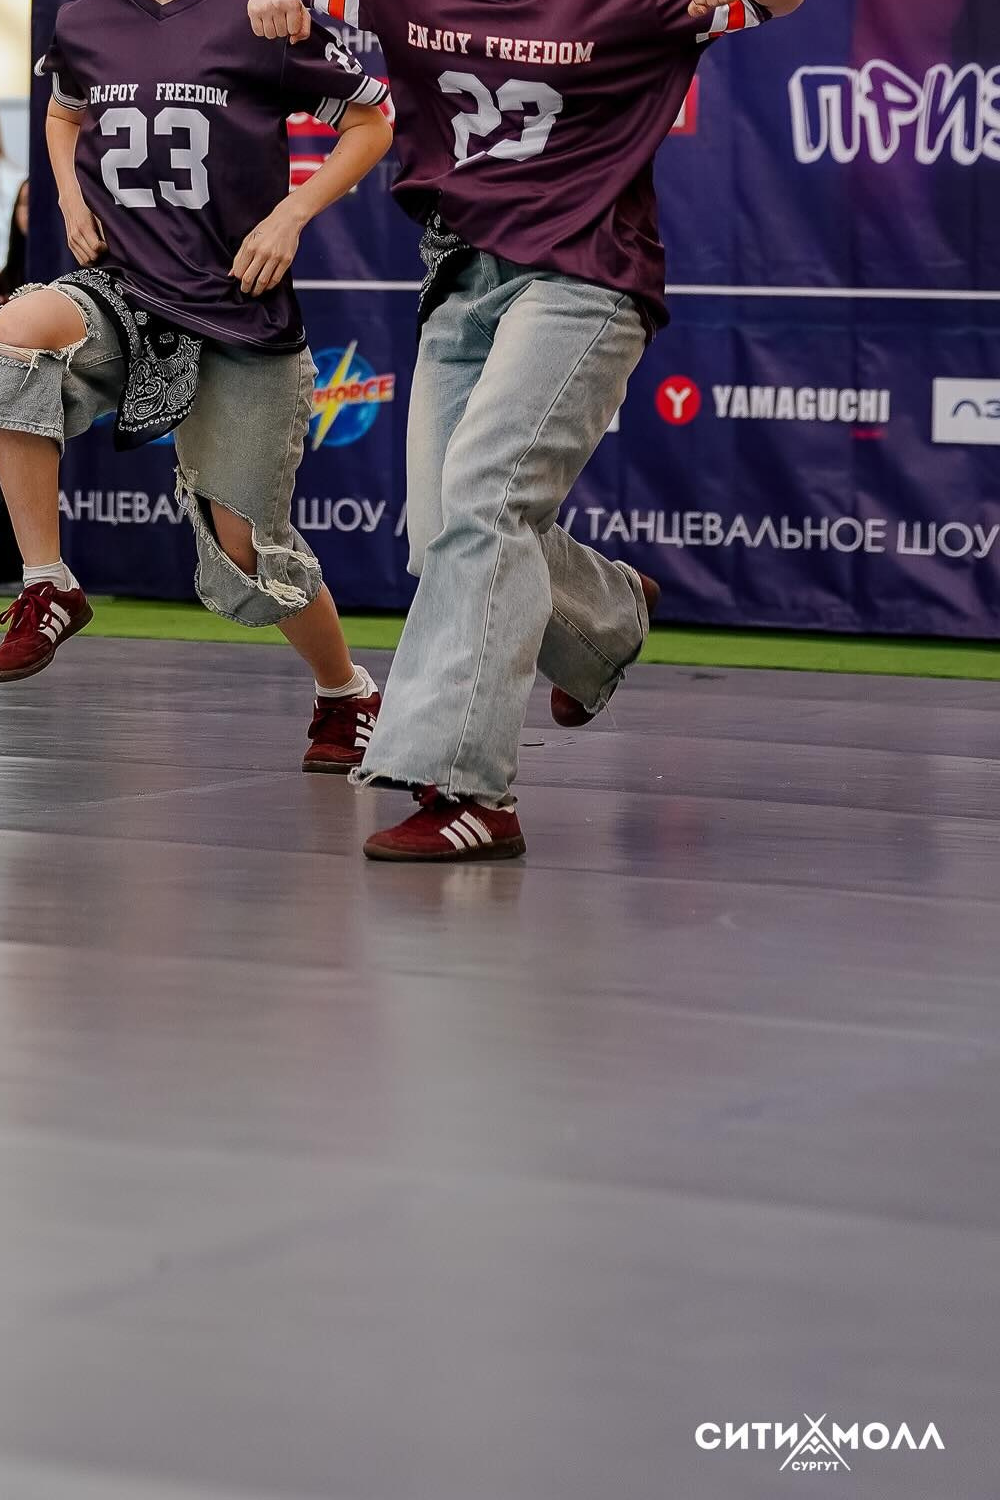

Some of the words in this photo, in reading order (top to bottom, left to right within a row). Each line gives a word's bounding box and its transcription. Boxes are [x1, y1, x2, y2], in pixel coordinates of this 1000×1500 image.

[407, 21, 472, 54] ENJOY
[485, 35, 595, 65] FREEDOM
[90, 83, 139, 105] ENJPOY
[155, 82, 229, 108] FREEDOM
[437, 70, 563, 170] 23
[99, 106, 210, 210] 23
[712, 385, 890, 422] YAMAGUCHI
[299, 497, 386, 533] ШОУ
[586, 507, 888, 554] ТАНЦЕВАЛЬНОЕ
[896, 520, 1000, 560] ШОУ
